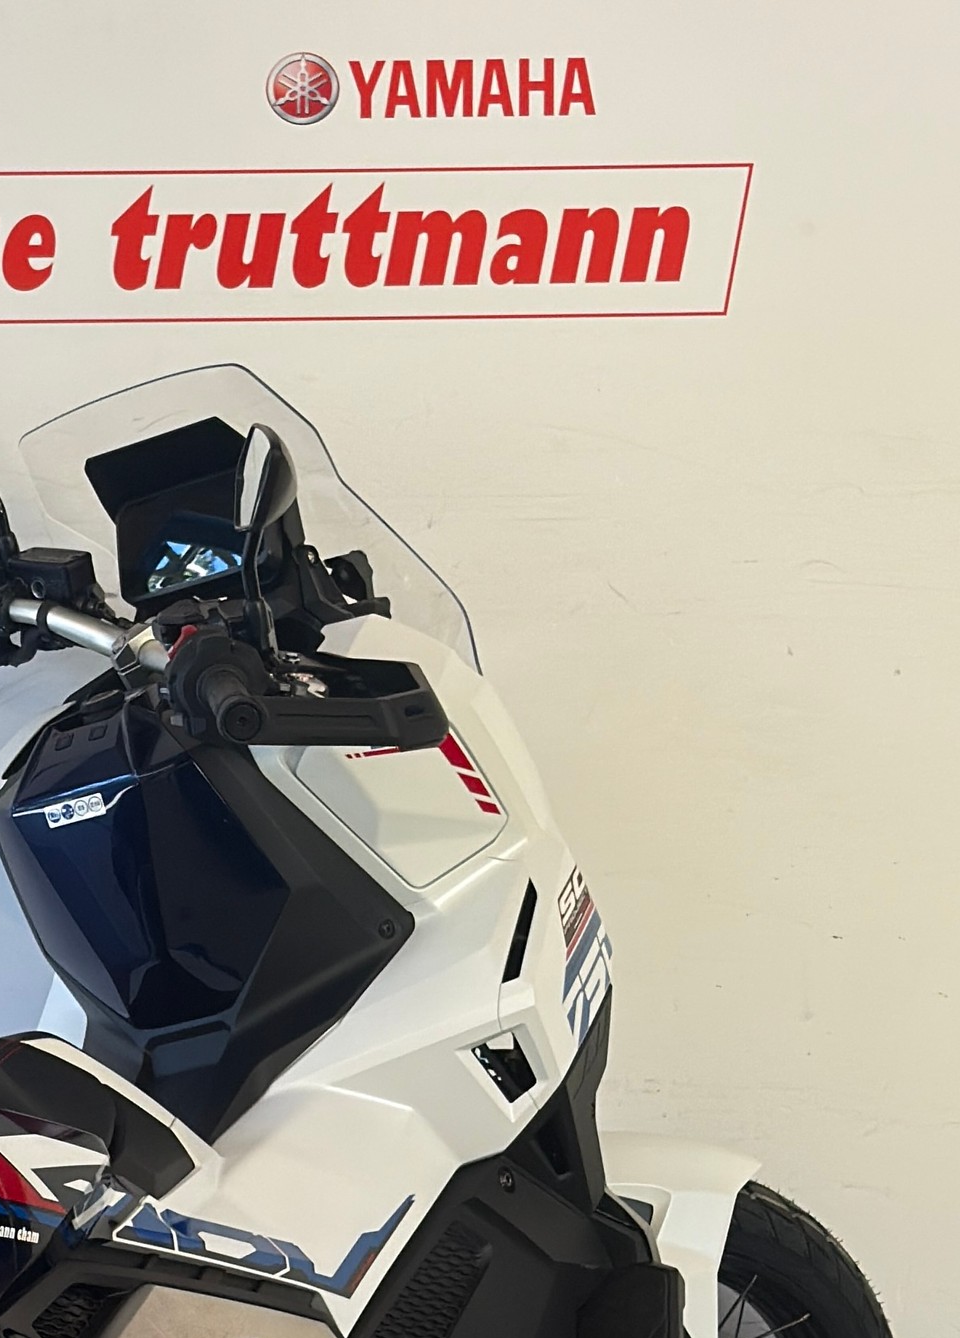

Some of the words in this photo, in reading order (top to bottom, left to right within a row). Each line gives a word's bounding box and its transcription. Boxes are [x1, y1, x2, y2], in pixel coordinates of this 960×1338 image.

[349, 57, 596, 119] YAMAHA
[110, 183, 691, 291] truttmann
[17, 1226, 40, 1244] cham
